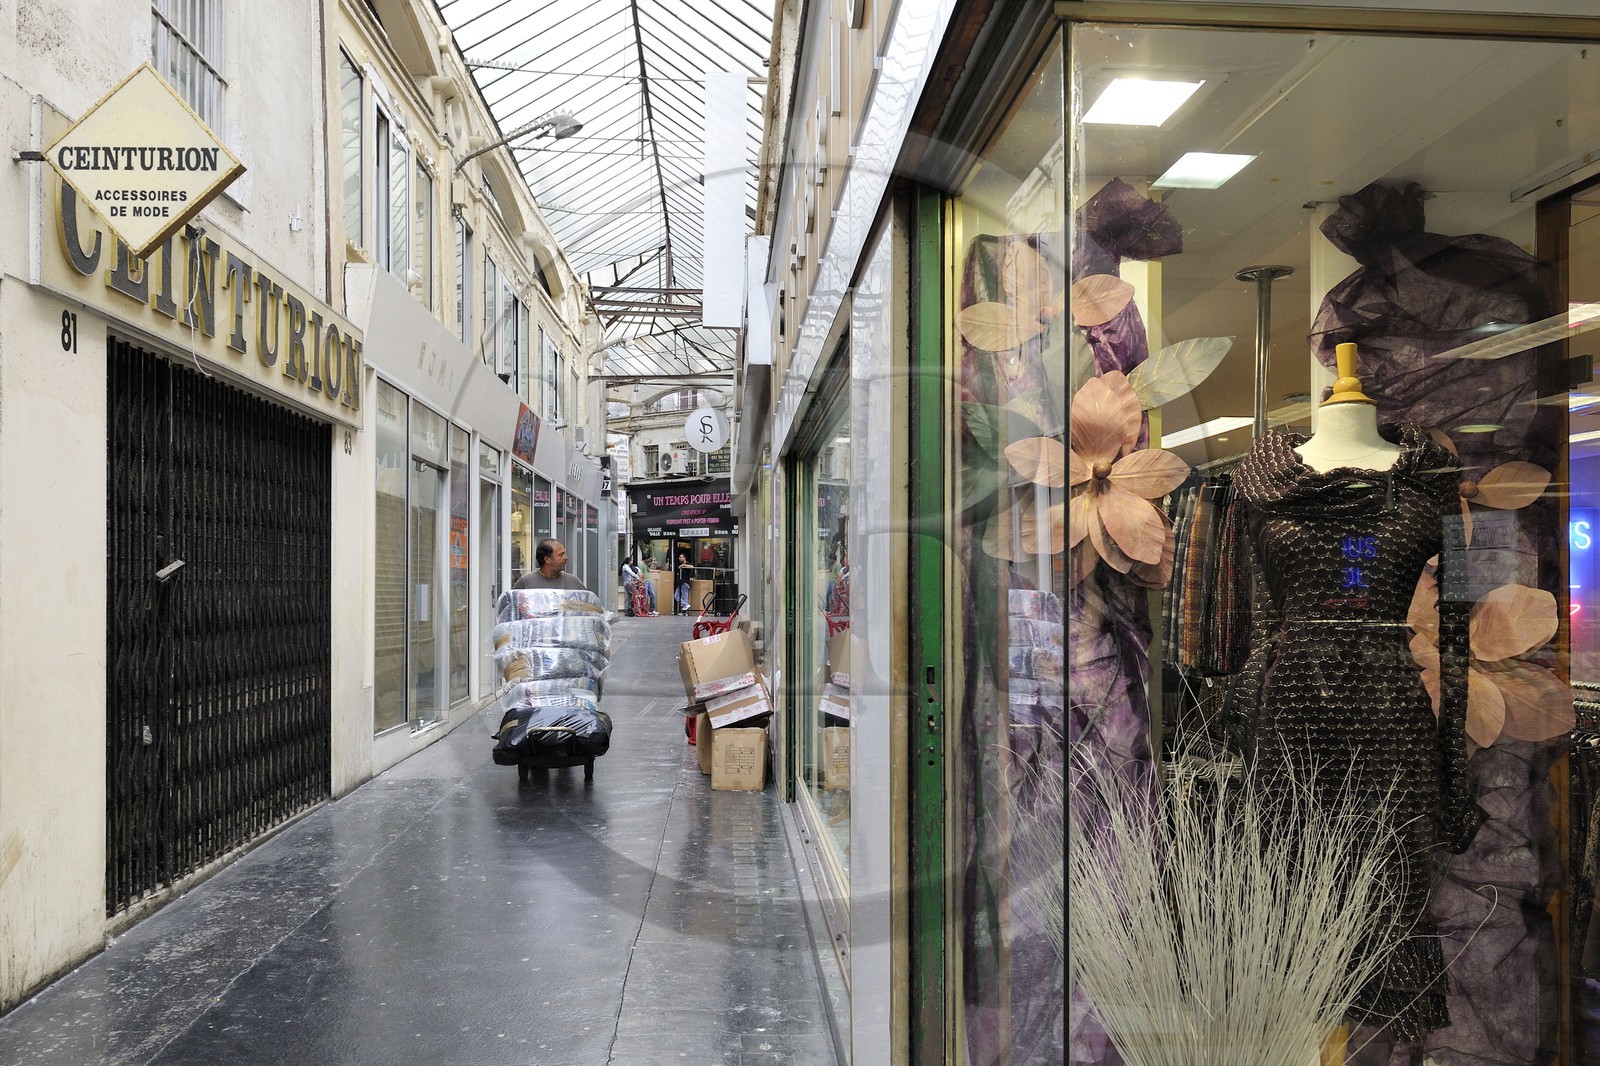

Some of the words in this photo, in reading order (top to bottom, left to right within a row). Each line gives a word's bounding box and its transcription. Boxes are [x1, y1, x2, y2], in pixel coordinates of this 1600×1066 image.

[58, 146, 219, 172] CEINTURION
[95, 189, 187, 202] ACCESSOIRES
[110, 206, 128, 218] DE
[133, 206, 169, 218] MODE
[61, 309, 77, 354] 81
[344, 430, 352, 455] 83
[653, 496, 664, 506] UN
[665, 495, 689, 506] TEMPS
[690, 494, 711, 504] POUR
[713, 492, 731, 503] ELLE
